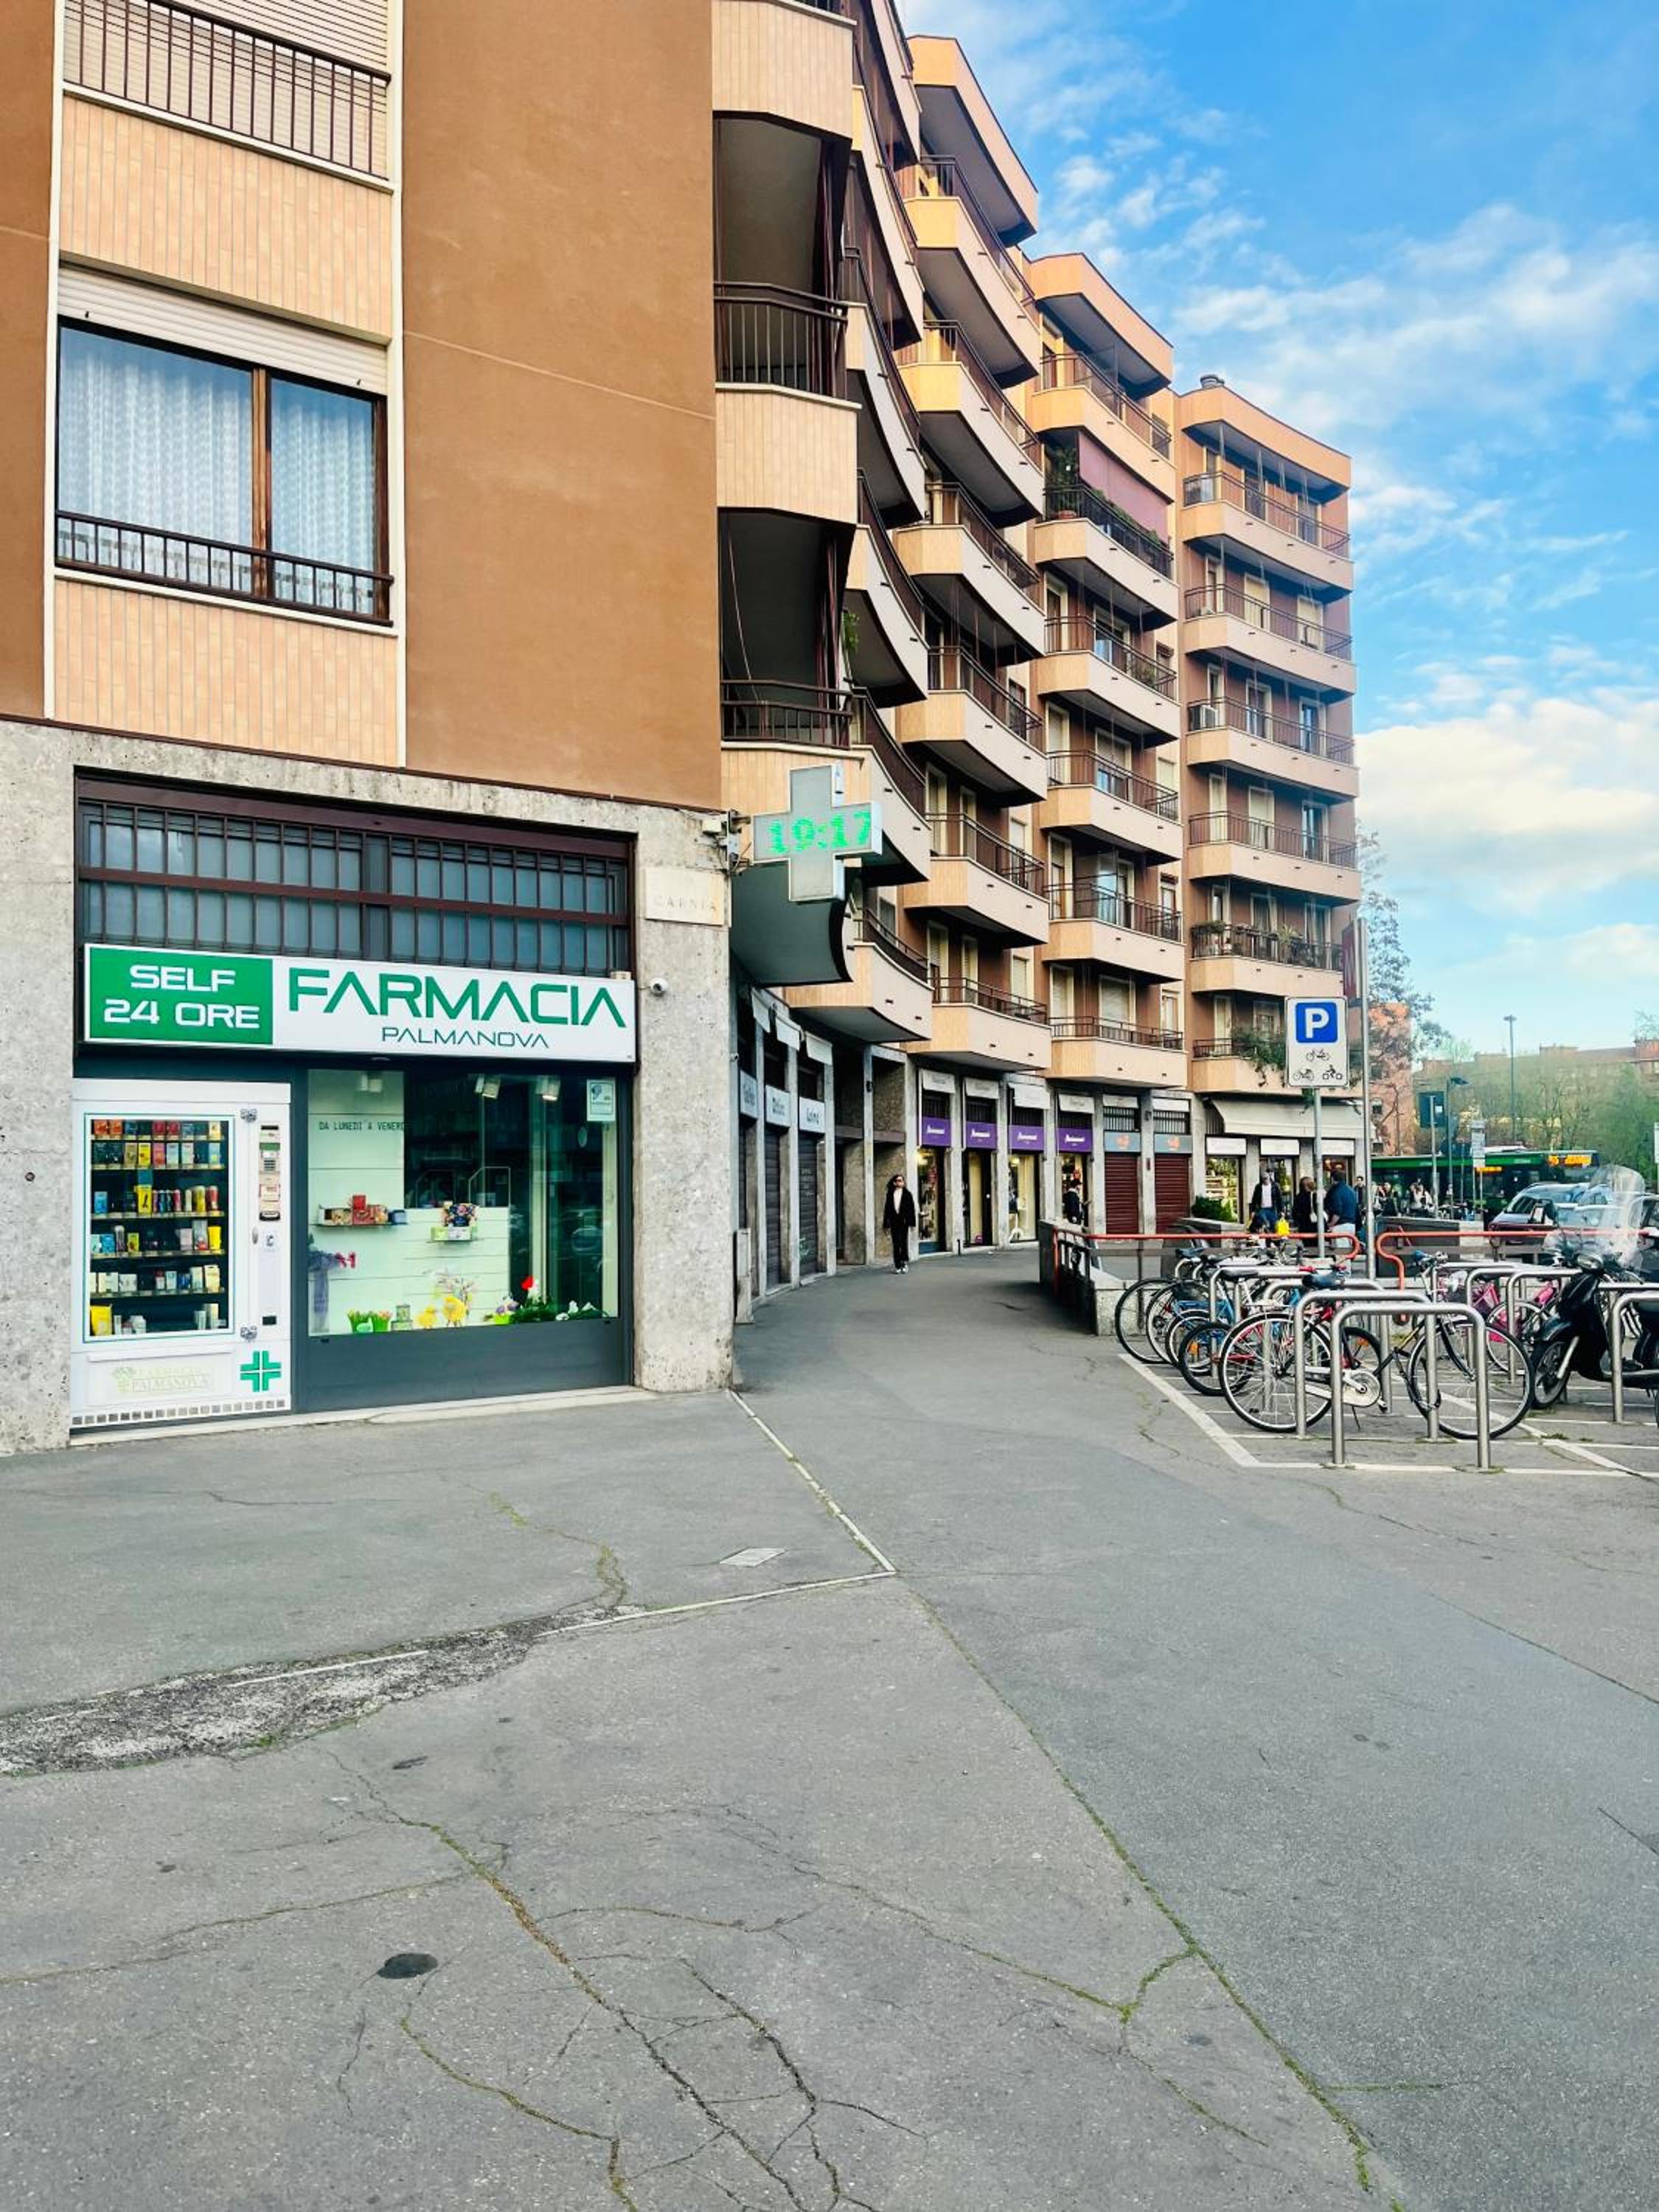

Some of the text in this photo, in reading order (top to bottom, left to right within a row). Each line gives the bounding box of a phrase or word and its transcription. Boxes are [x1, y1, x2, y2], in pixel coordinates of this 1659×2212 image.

[768, 810, 871, 854] 19:17
[129, 964, 236, 992] SELF
[288, 967, 627, 1028] FARMACIA
[104, 998, 260, 1029] 24 ORE
[1304, 1008, 1329, 1039] P
[382, 1026, 549, 1049] PALMANOVA
[319, 1121, 330, 1130] DA
